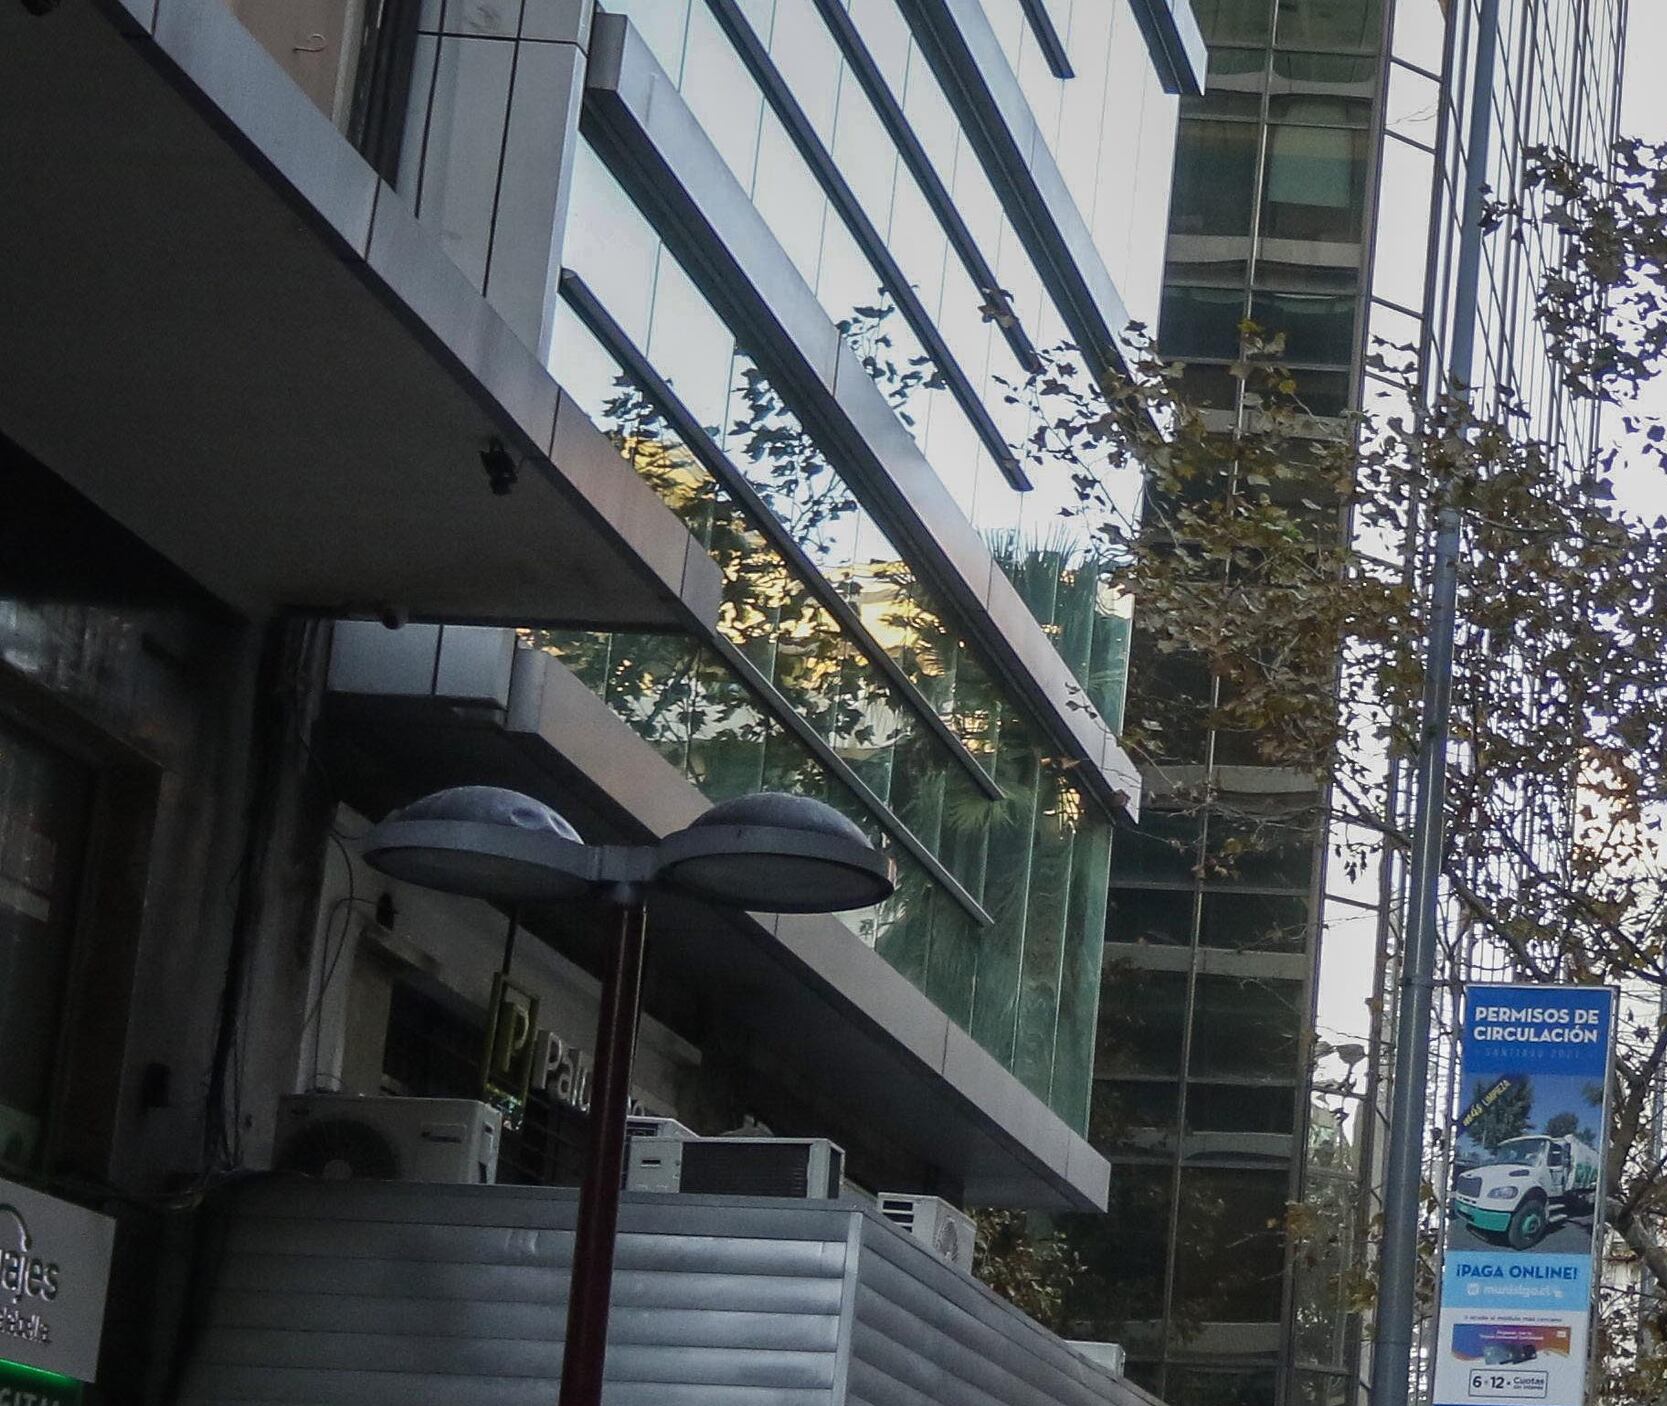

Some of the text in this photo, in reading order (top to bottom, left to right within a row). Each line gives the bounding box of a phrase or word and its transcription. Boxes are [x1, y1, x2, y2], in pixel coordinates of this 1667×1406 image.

[1475, 1006, 1600, 1025] PERMISOS DE
[1473, 1024, 1598, 1043] CIRCULACIÓN
[0, 1249, 59, 1305] ajes
[1509, 1265, 1578, 1280] ONLINE!
[1490, 1376, 1505, 1389] 12
